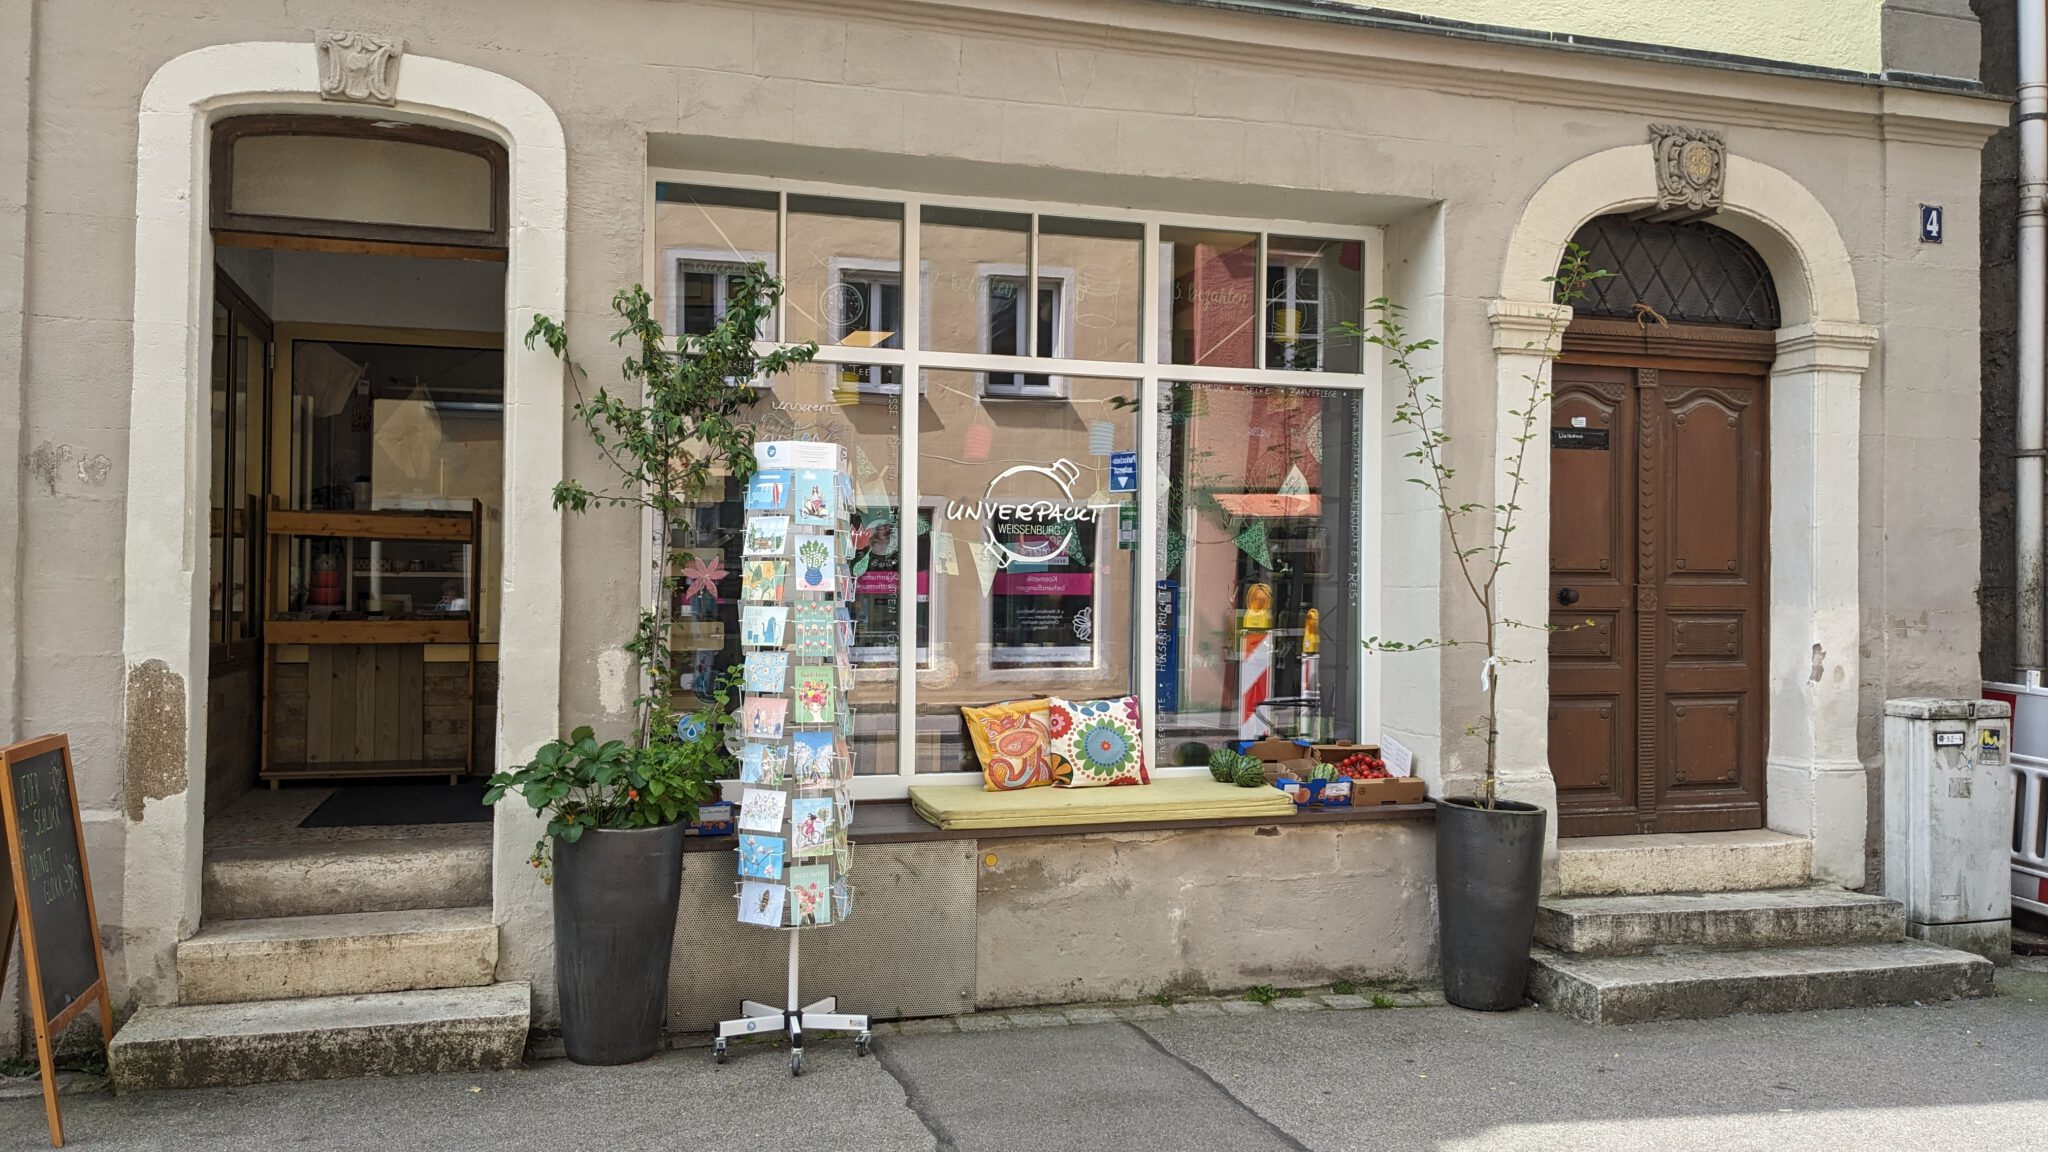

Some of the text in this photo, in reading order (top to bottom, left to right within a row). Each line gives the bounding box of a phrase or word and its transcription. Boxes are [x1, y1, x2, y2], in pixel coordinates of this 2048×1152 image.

[1926, 210, 1939, 237] 4
[946, 500, 1121, 524] UNVERPACKT
[997, 523, 1062, 536] WEISSENBURG
[1347, 572, 1360, 600] REIS
